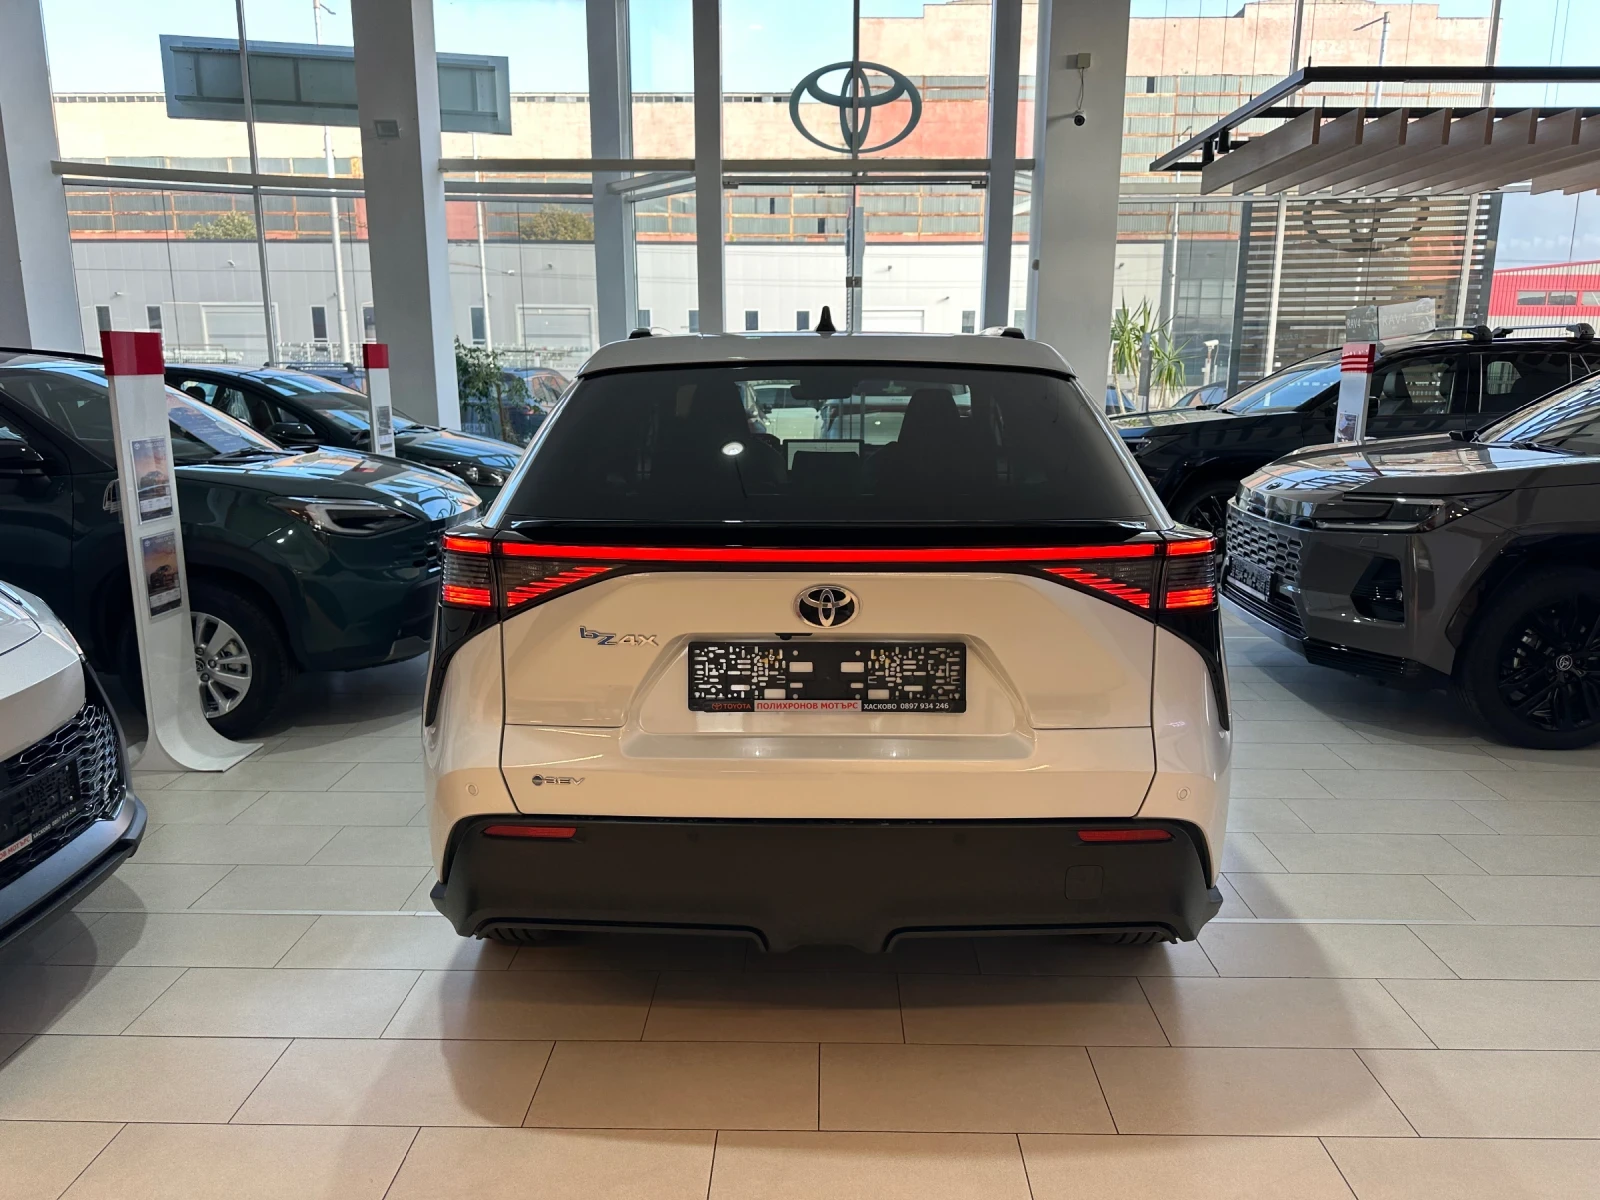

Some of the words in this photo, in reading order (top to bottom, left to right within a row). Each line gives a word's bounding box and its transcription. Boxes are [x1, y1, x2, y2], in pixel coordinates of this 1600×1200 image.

[1347, 318, 1361, 329] RAV4
[1382, 313, 1407, 326] RAV4
[723, 702, 752, 710] TOYOTA
[756, 702, 818, 710] ПОЛИХРОНОВ
[900, 702, 918, 710] 0897
